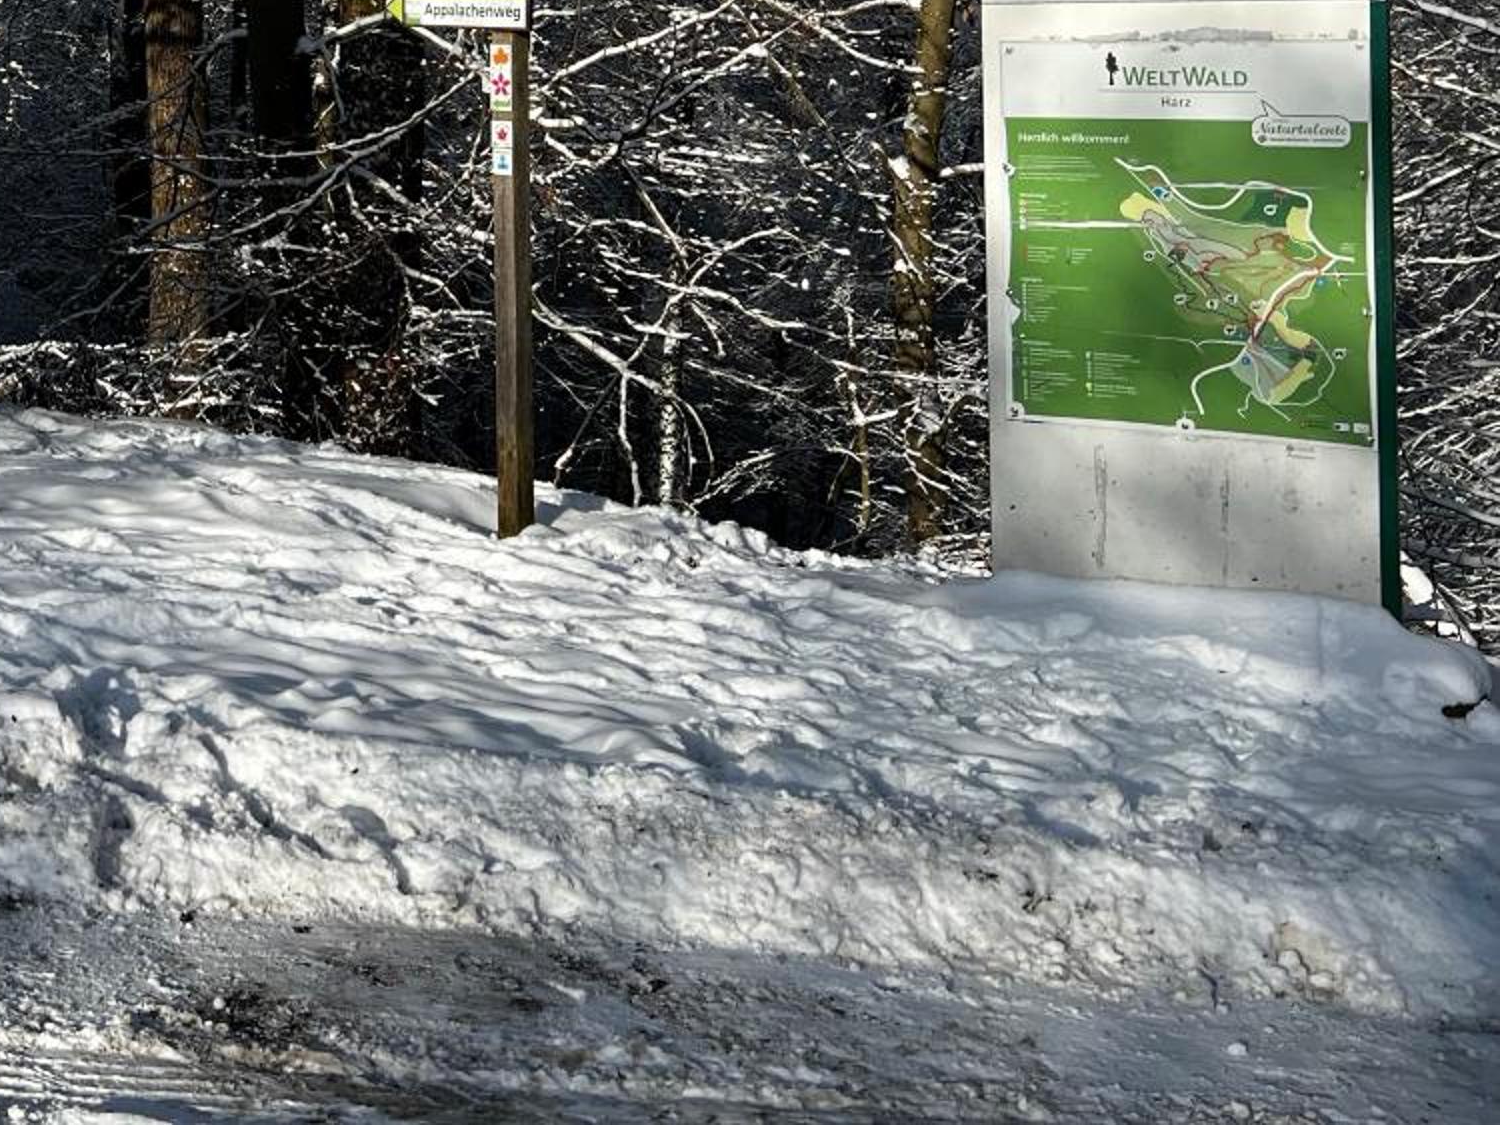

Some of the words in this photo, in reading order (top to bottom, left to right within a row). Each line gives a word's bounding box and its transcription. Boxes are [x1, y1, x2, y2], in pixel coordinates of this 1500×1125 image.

[424, 3, 521, 21] Appalachenweg
[1160, 97, 1192, 108] Harz
[1018, 132, 1059, 143] Herzlich
